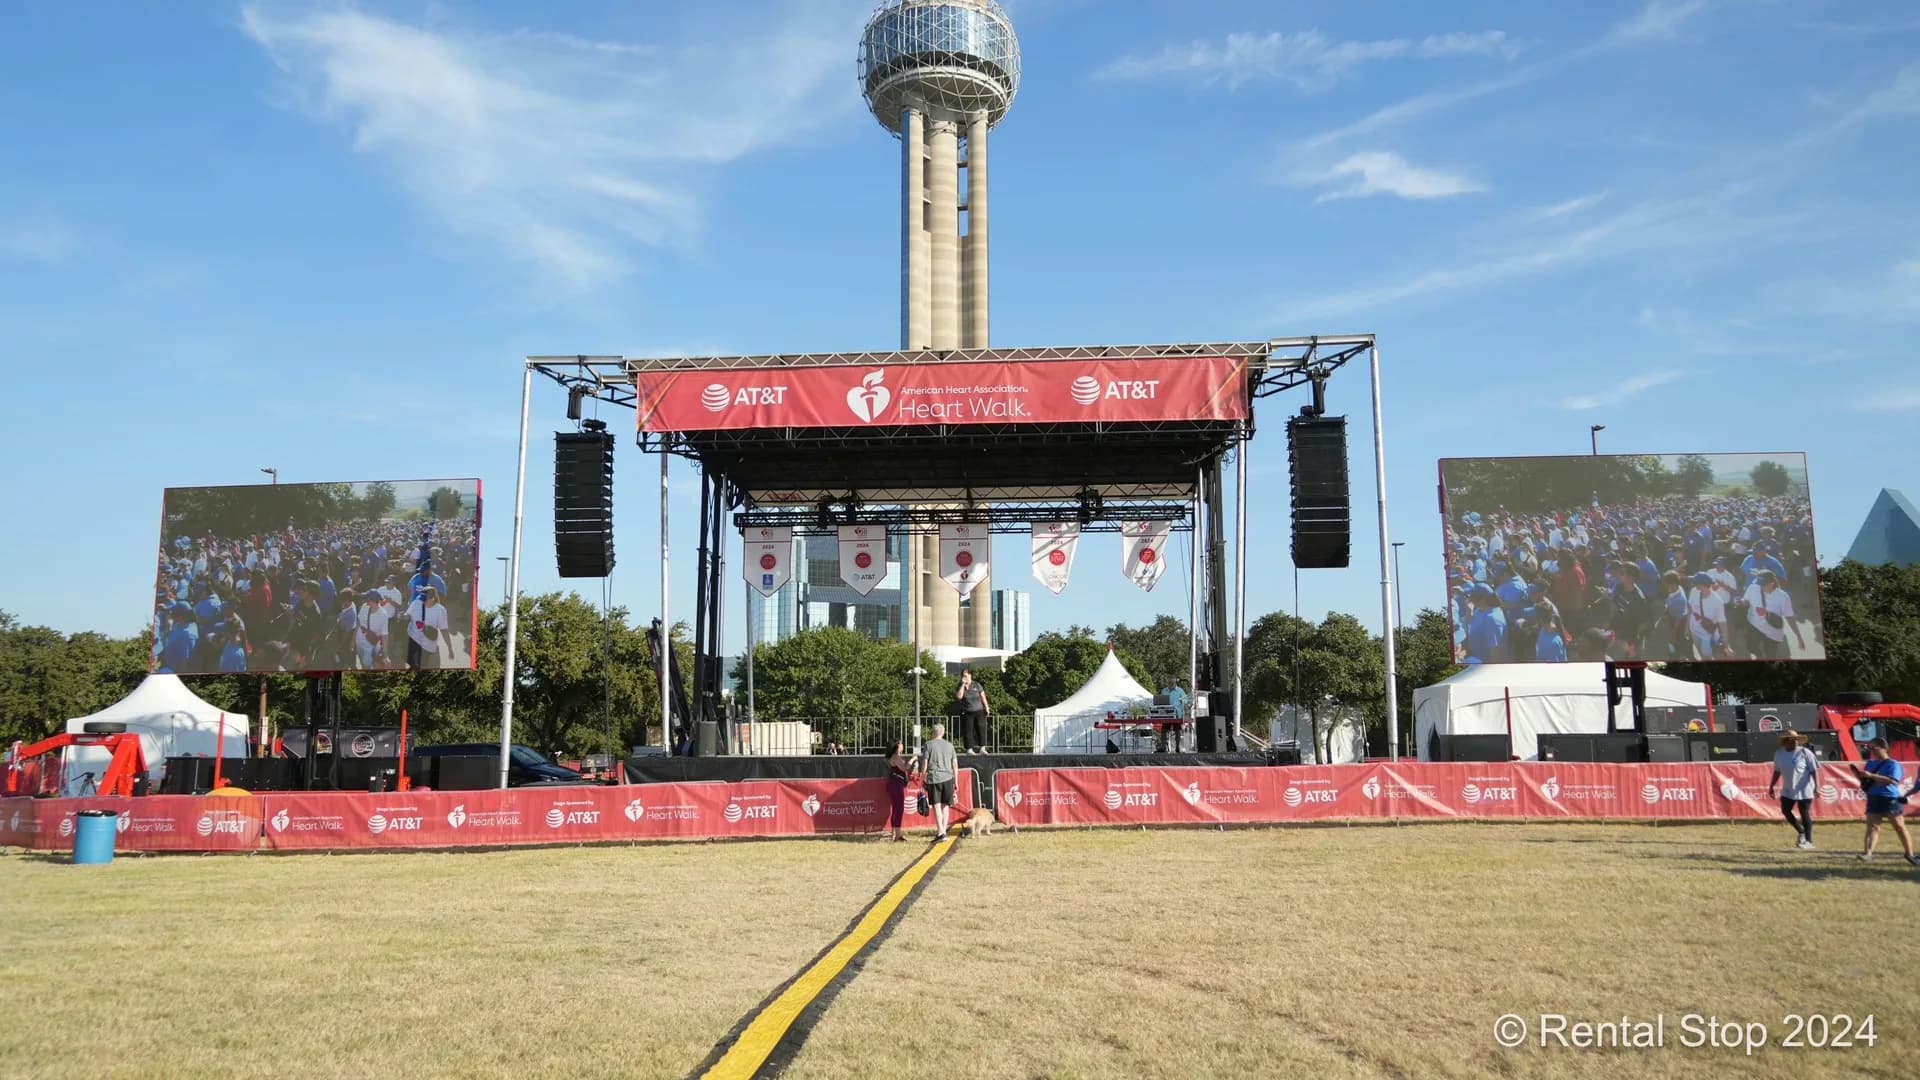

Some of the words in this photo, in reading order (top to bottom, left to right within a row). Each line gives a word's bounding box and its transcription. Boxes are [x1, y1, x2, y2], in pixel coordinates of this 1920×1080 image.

[734, 386, 788, 406] AT&T
[900, 386, 944, 396] American
[945, 385, 972, 395] Heart
[1105, 380, 1160, 400] AT&T
[899, 398, 964, 419] Heart
[1124, 793, 1158, 806] AT&T
[1204, 794, 1231, 804] Heart
[1303, 789, 1338, 803] AT&T
[1482, 787, 1517, 801] AT&T
[1661, 788, 1696, 801] AT&T
[1839, 788, 1868, 801] AT&
[566, 811, 601, 824] AT&T
[646, 810, 672, 820] Heart
[743, 805, 778, 819] AT&T
[214, 820, 247, 833] AT&T
[292, 821, 318, 832] Heart
[389, 817, 423, 830] AT&T
[468, 816, 495, 827] Heart
